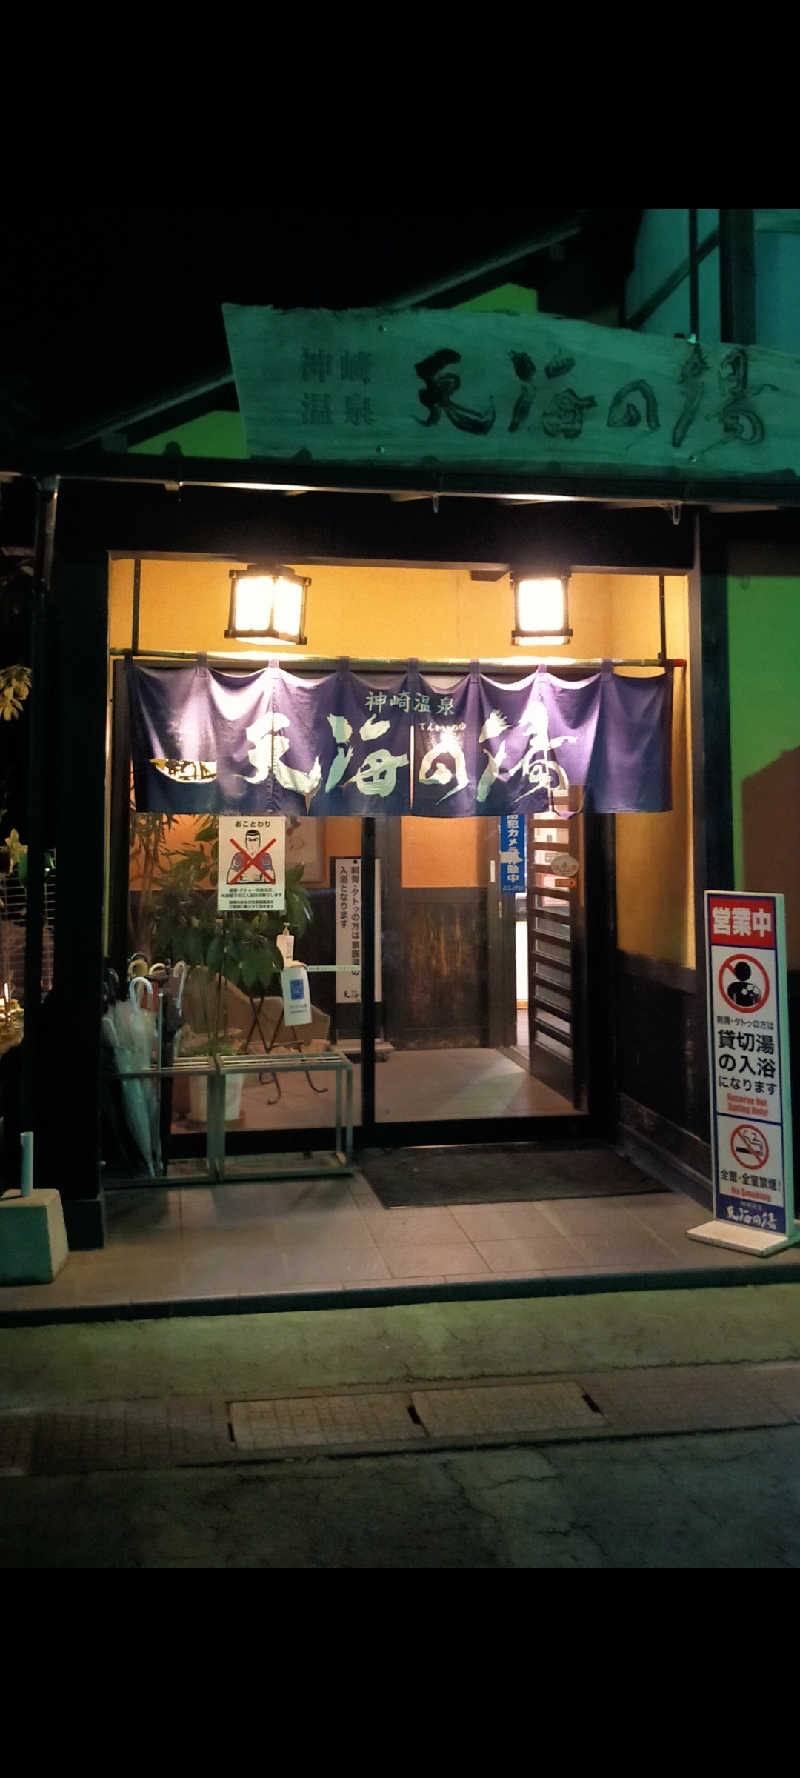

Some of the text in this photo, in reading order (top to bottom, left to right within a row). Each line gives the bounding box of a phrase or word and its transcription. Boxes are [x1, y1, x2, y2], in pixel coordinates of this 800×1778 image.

[412, 346, 778, 452] 天海の湯
[364, 691, 456, 716] 神崎温泉
[232, 700, 576, 806] 天海の湯
[235, 820, 272, 829] おことわり
[712, 907, 773, 938] 営業中
[718, 1029, 776, 1056] 貸切湯
[718, 1053, 777, 1079] の入浴
[718, 1075, 777, 1097] になります
